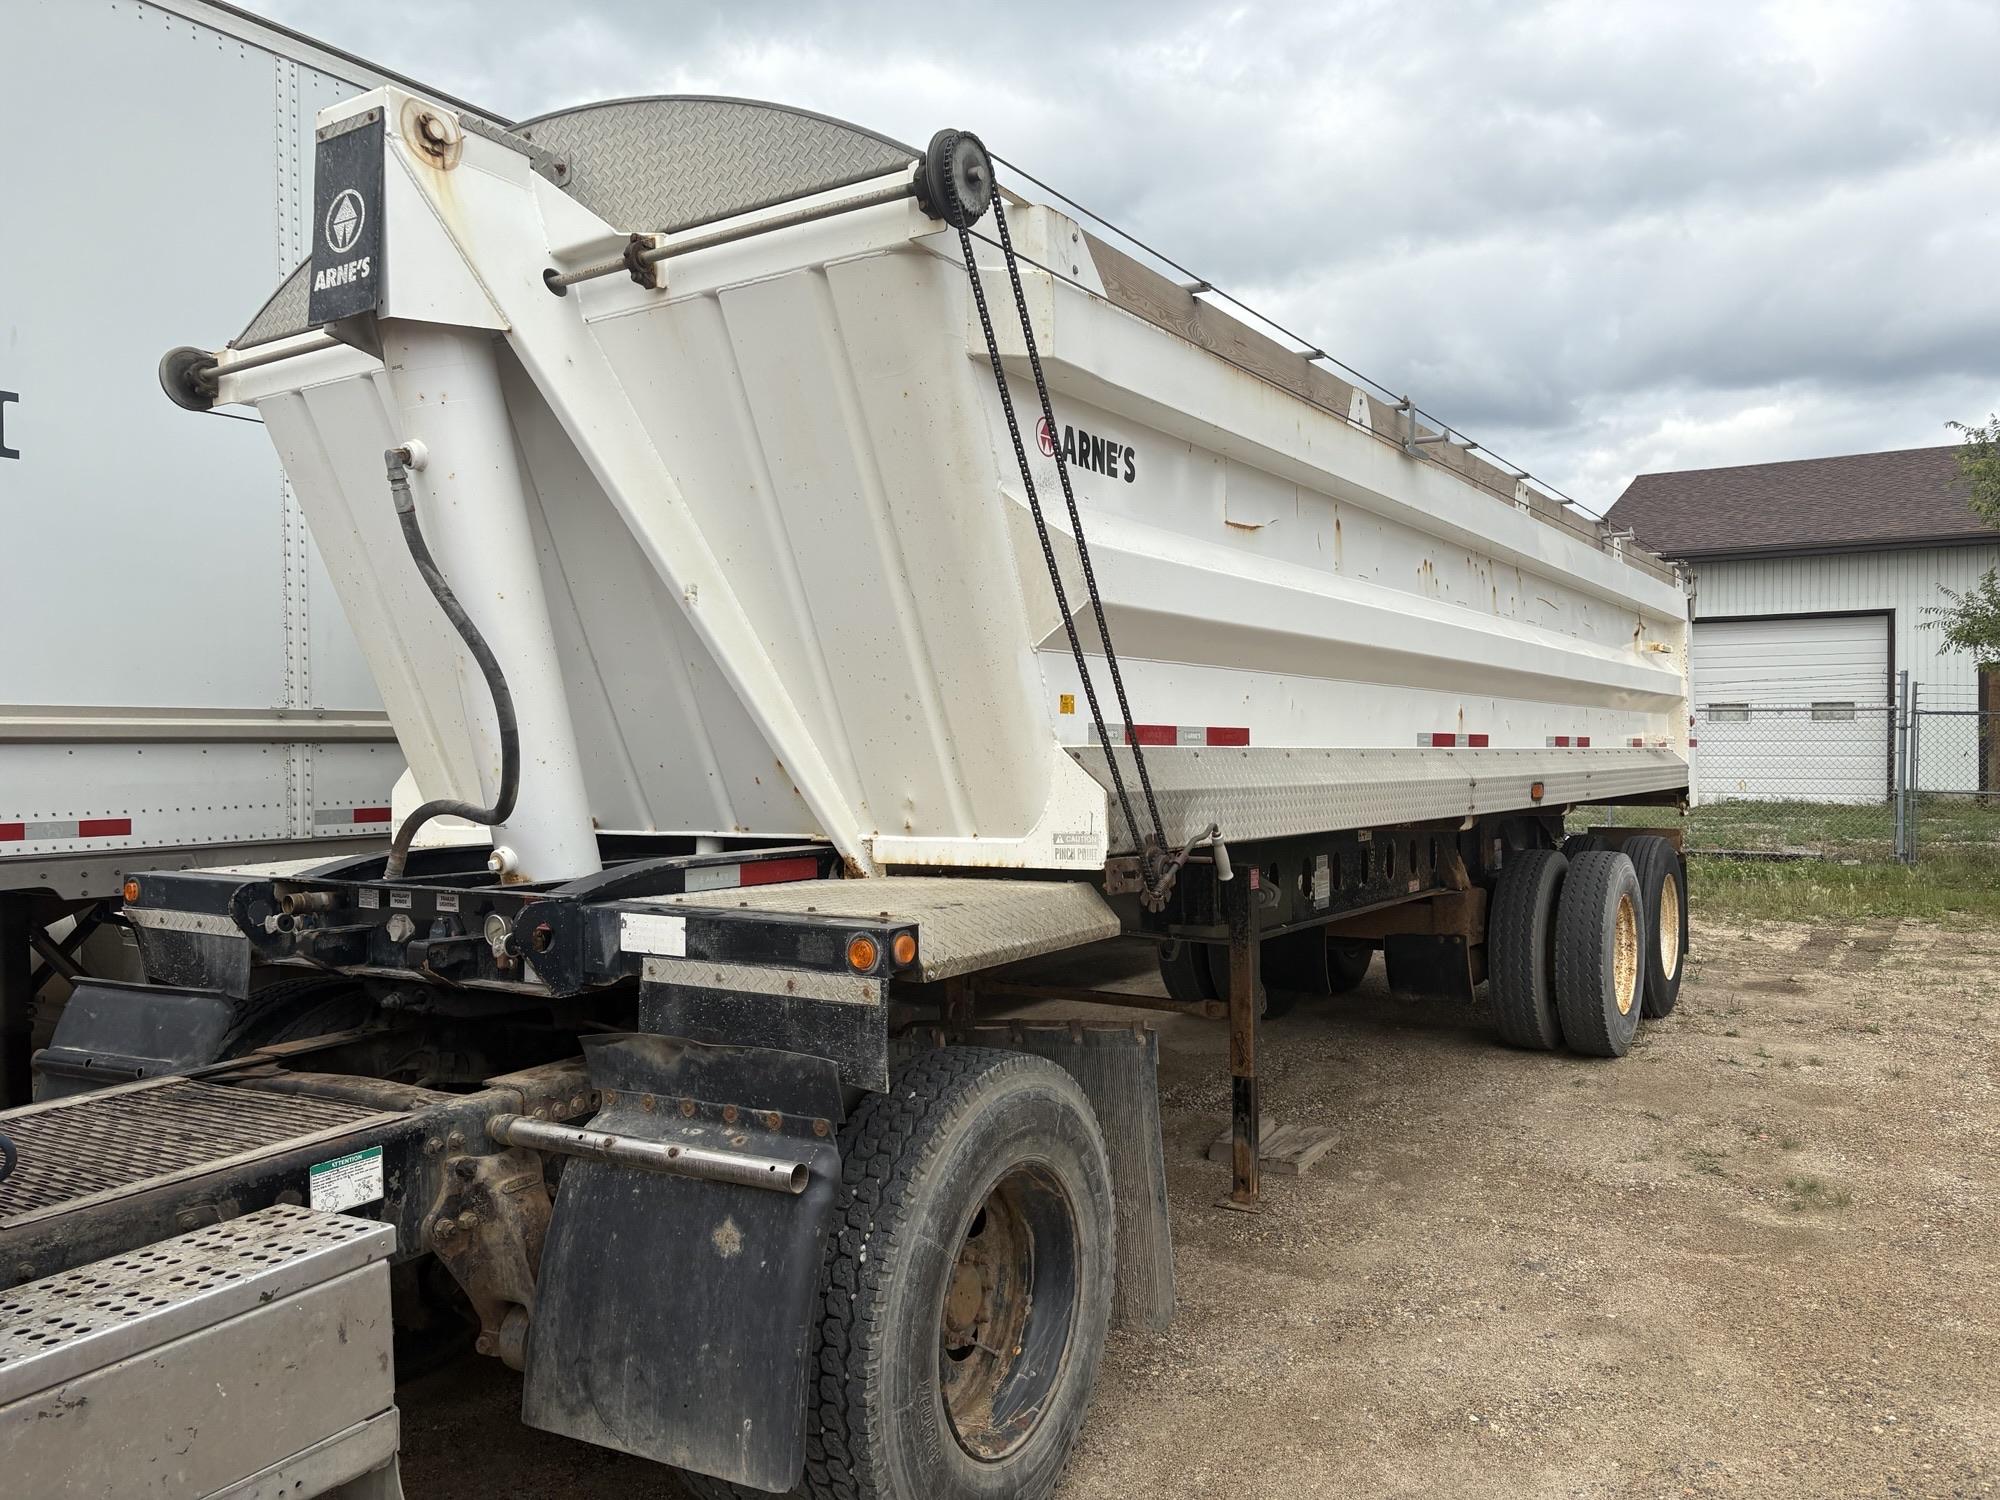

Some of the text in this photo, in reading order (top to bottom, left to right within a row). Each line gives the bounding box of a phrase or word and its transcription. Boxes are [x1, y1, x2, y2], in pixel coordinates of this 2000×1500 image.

[313, 256, 371, 292] ARNE'S
[1062, 425, 1136, 484] ARNE'S
[1055, 847, 1076, 861] PINCH
[331, 1155, 363, 1168] ATTENTION
